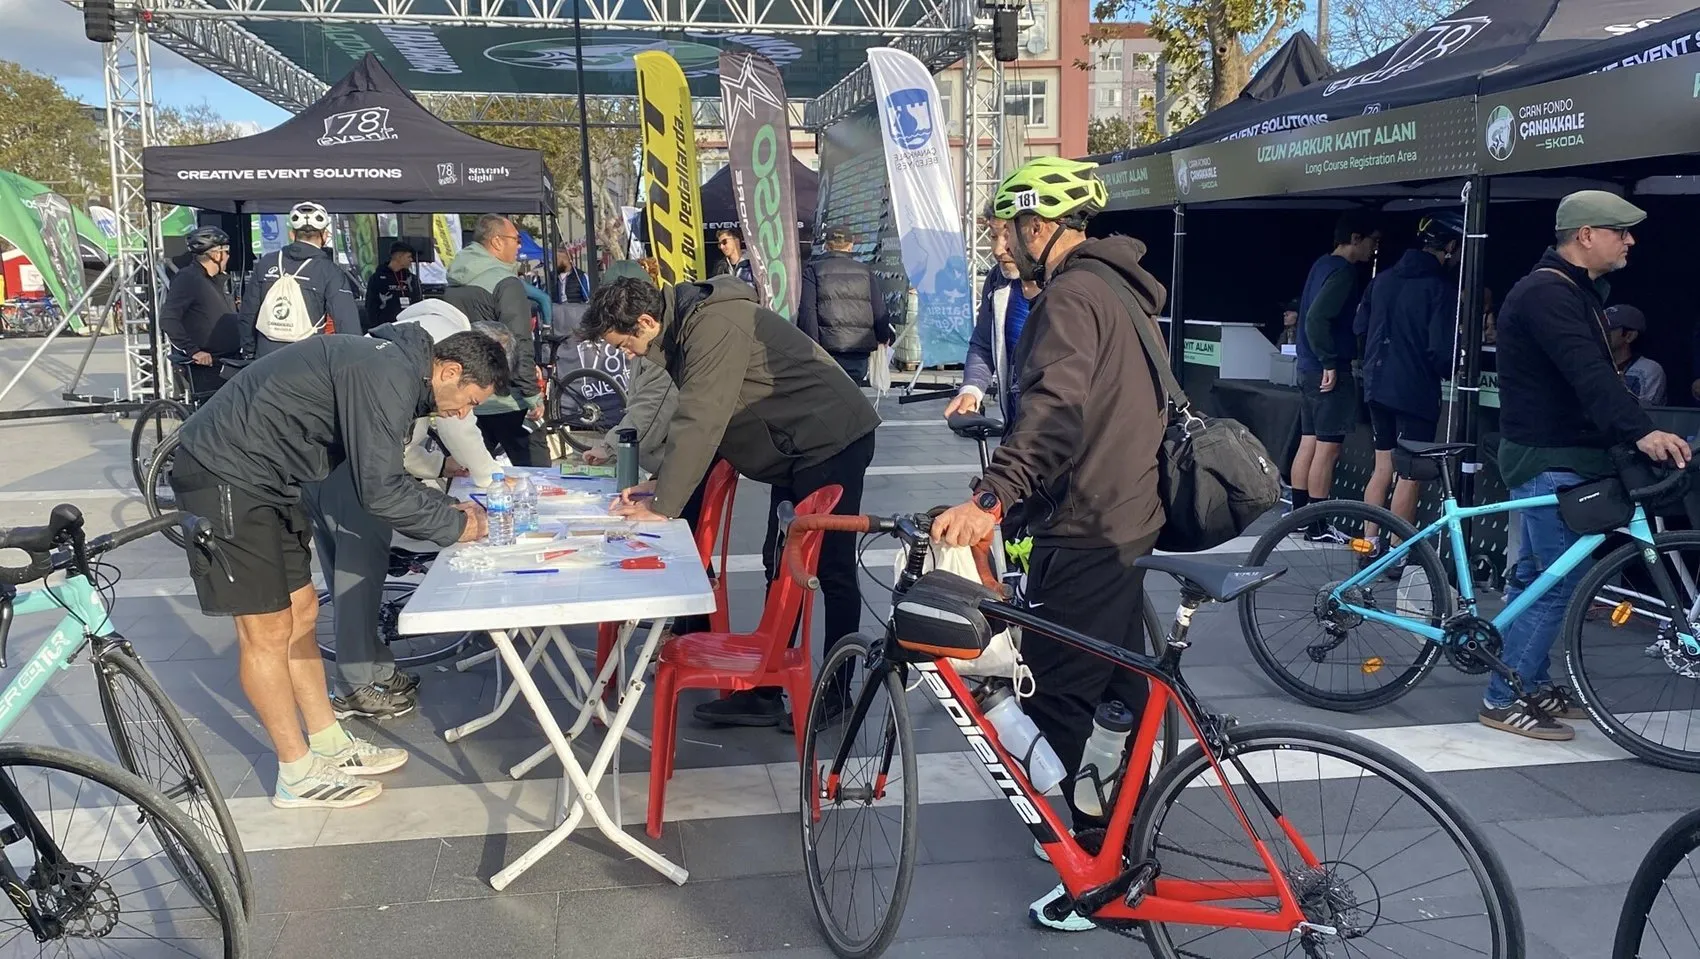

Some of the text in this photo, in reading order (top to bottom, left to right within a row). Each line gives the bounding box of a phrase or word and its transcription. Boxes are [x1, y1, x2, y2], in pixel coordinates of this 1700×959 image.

[1622, 34, 1692, 68] EVENT
[1519, 98, 1574, 119] GRAN FONDO
[336, 111, 381, 135] 78
[1260, 113, 1330, 136] SOLUTIONS
[1519, 112, 1585, 140] ÇANAKKALE
[1257, 121, 1416, 164] UZUN PARKUR KAYIT ALANI
[1545, 135, 1585, 149] SKODA
[177, 167, 403, 180] CREATIVE EVENT SOLUTIONS
[1305, 149, 1418, 176] Long Course Registration Area
[1129, 167, 1149, 183] ALANI
[1018, 192, 1036, 208] 181
[682, 224, 695, 259] Bu
[1196, 342, 1214, 353] ALANI
[912, 659, 1042, 825] lapierre
